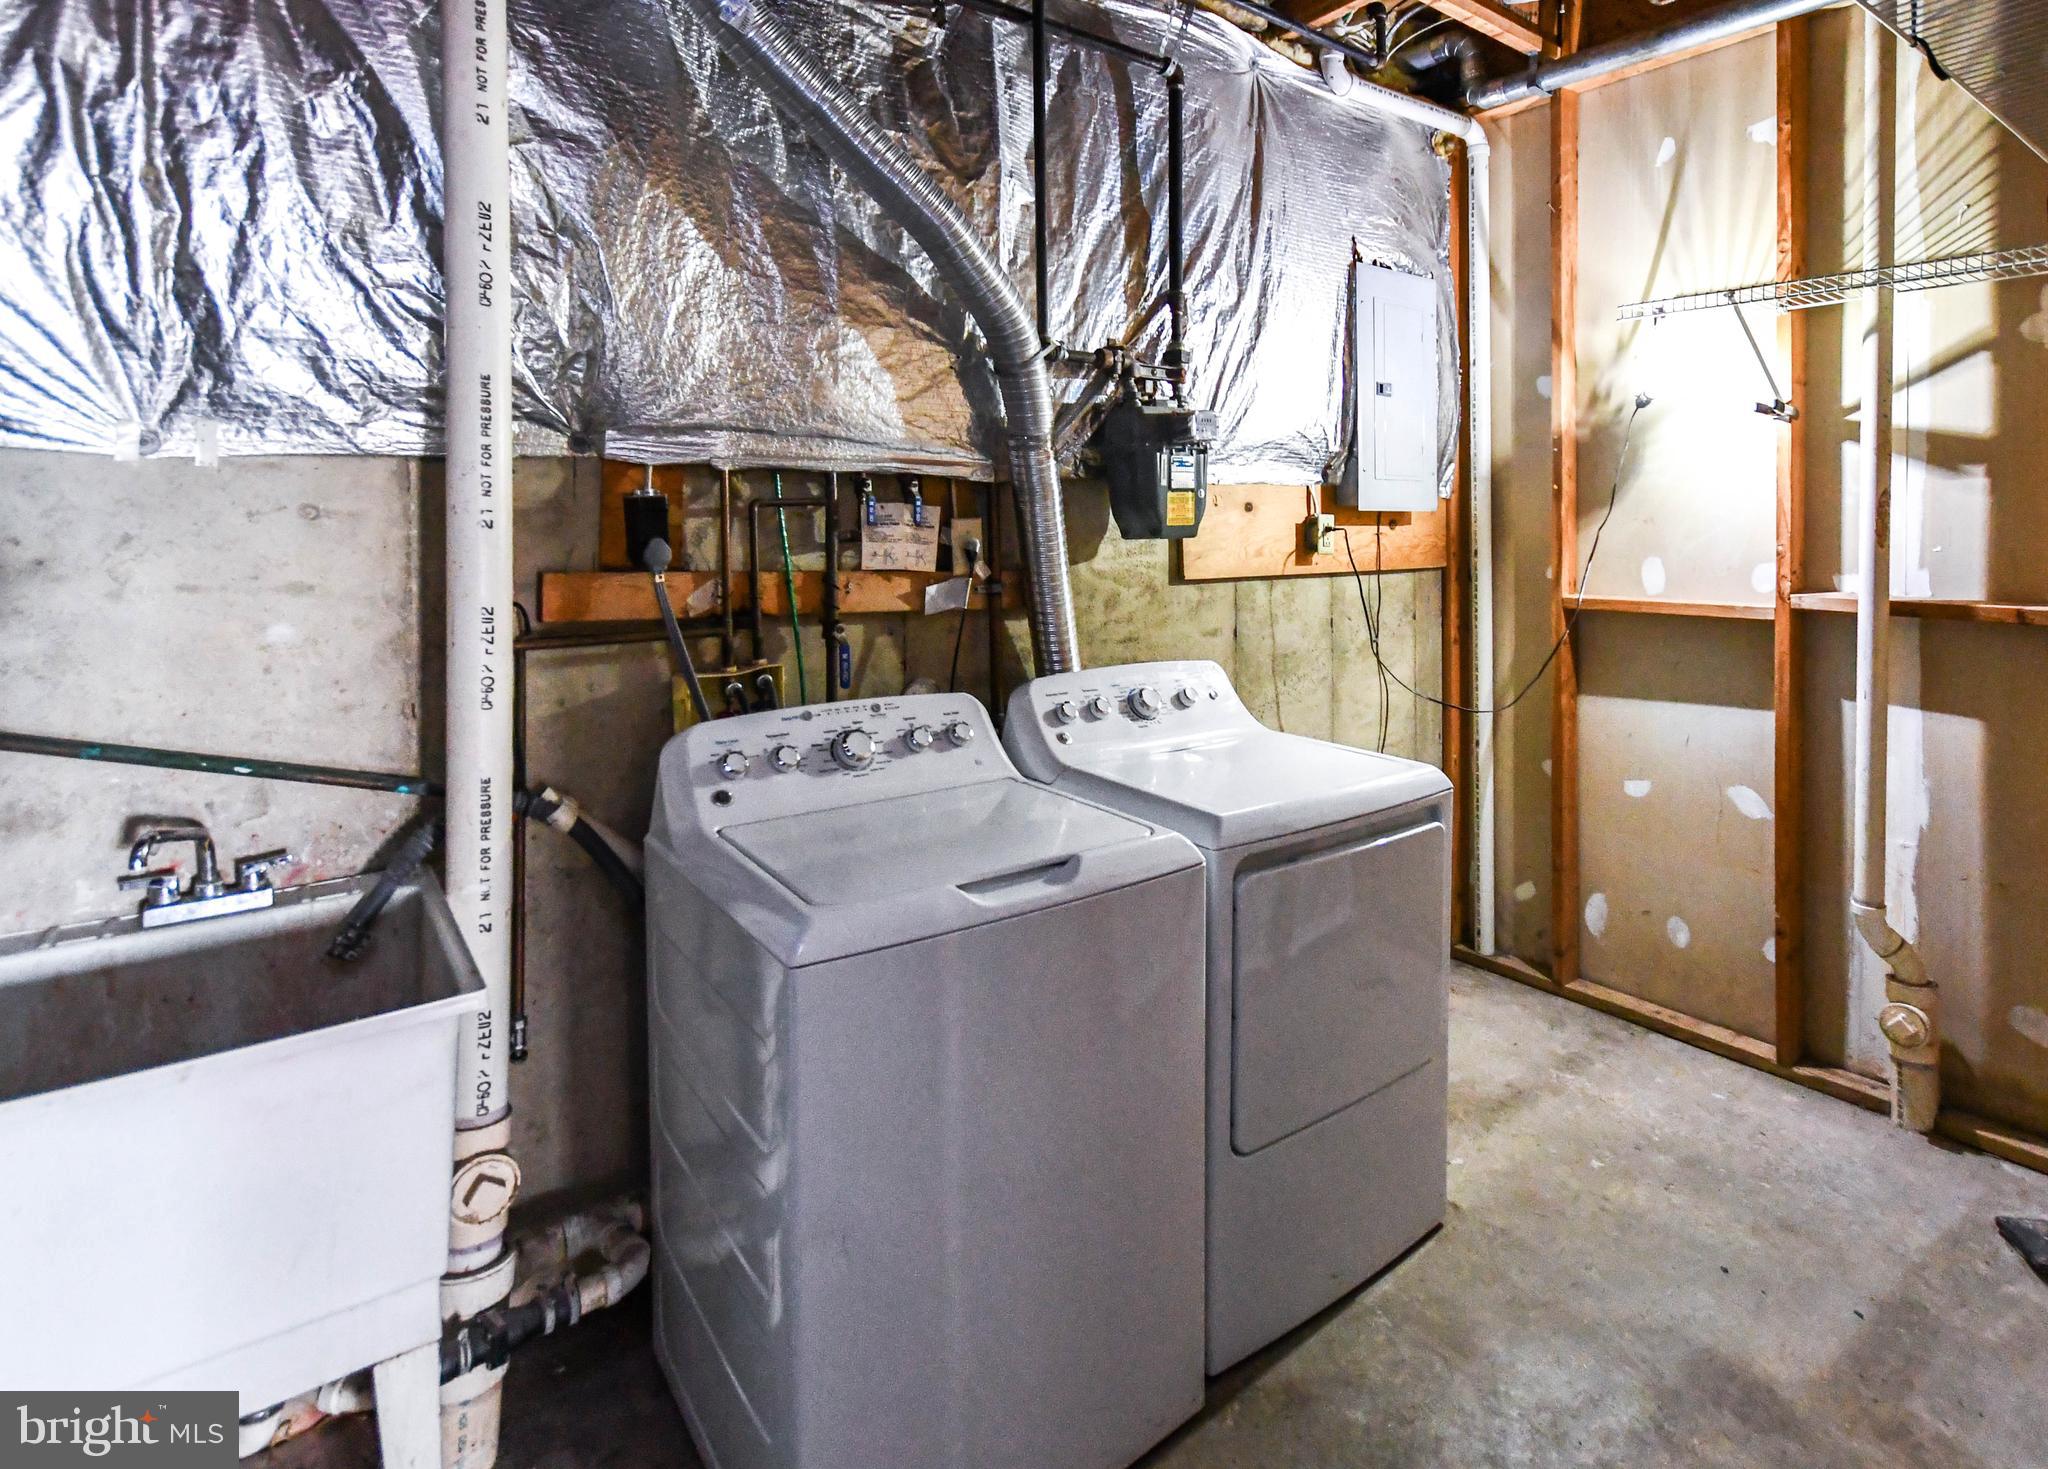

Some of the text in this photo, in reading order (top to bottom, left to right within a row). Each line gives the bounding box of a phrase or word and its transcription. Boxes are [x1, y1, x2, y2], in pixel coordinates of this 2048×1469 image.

[475, 37, 487, 61] FOR
[475, 66, 488, 92] NOT
[480, 443, 492, 467] FOR
[480, 474, 492, 497] NOT
[480, 847, 492, 870] FOR
